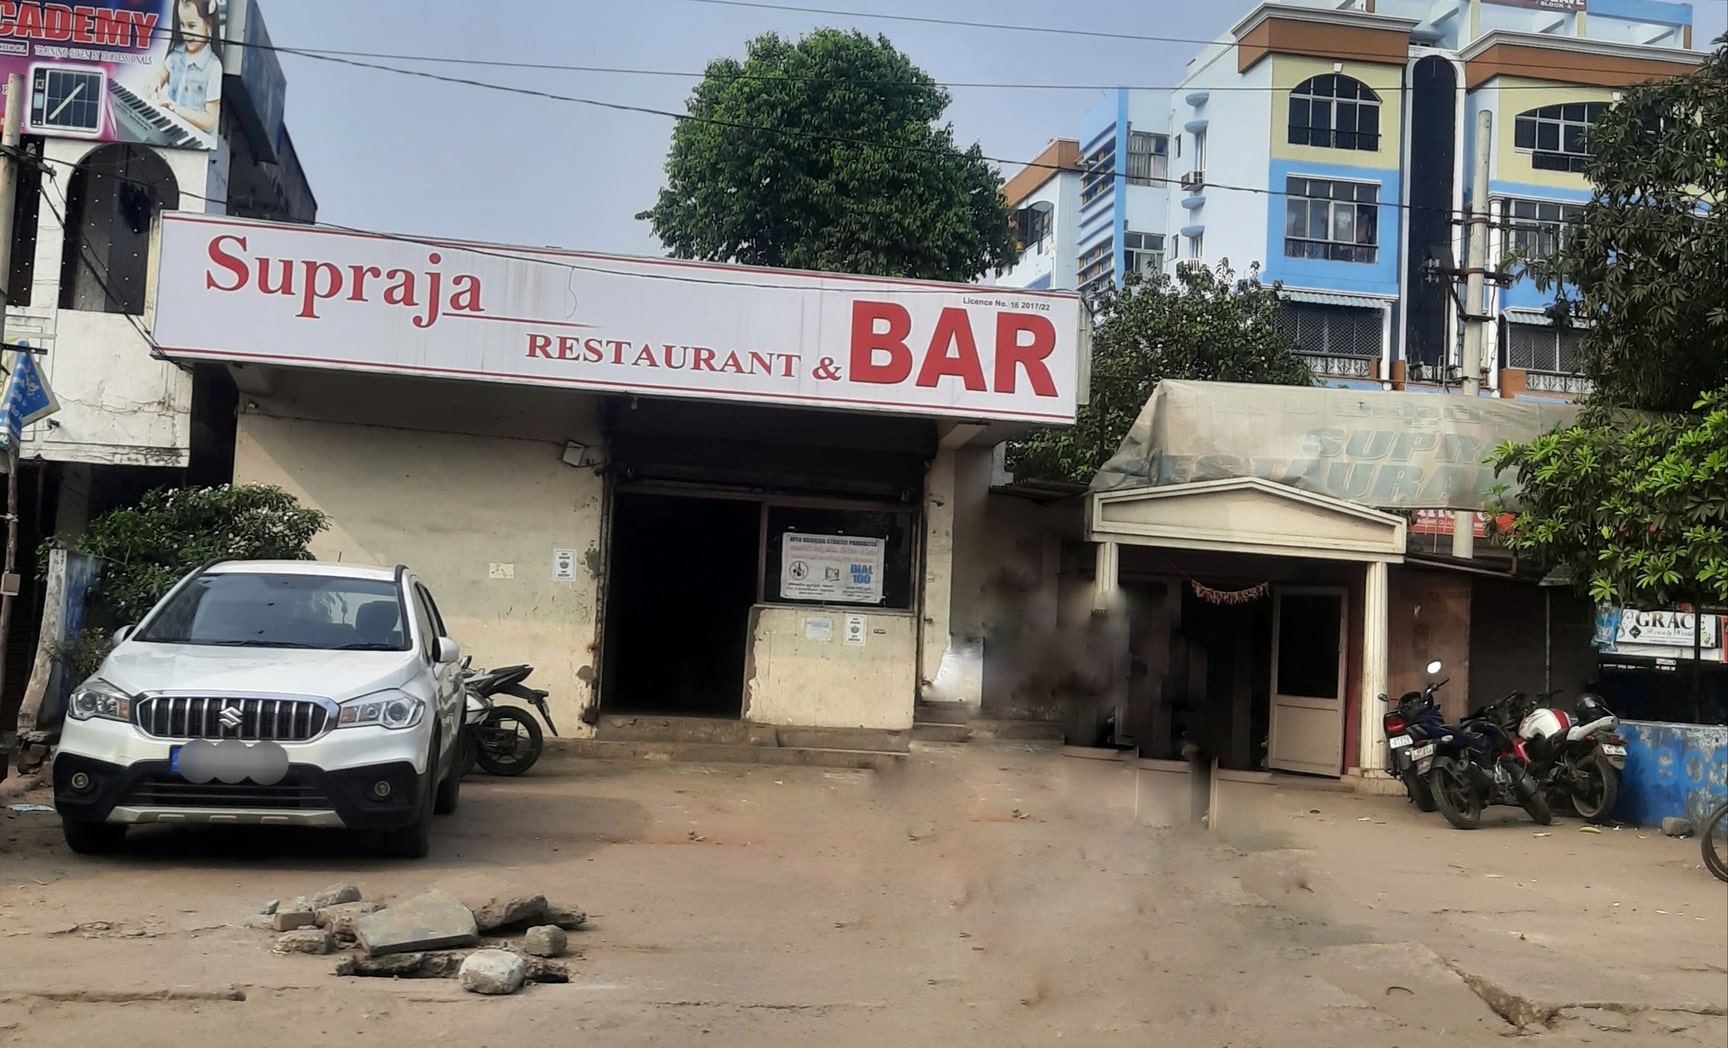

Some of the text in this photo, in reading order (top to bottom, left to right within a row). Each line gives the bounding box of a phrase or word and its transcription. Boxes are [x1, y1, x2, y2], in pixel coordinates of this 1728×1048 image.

[206, 235, 485, 328] Supraja
[963, 297, 993, 306] Licence
[995, 300, 1009, 308] No.
[1021, 302, 1050, 311] 2017/22
[526, 300, 1060, 398] RESTAURANT & BAR
[850, 563, 873, 575] DIAL
[852, 574, 871, 585] 100
